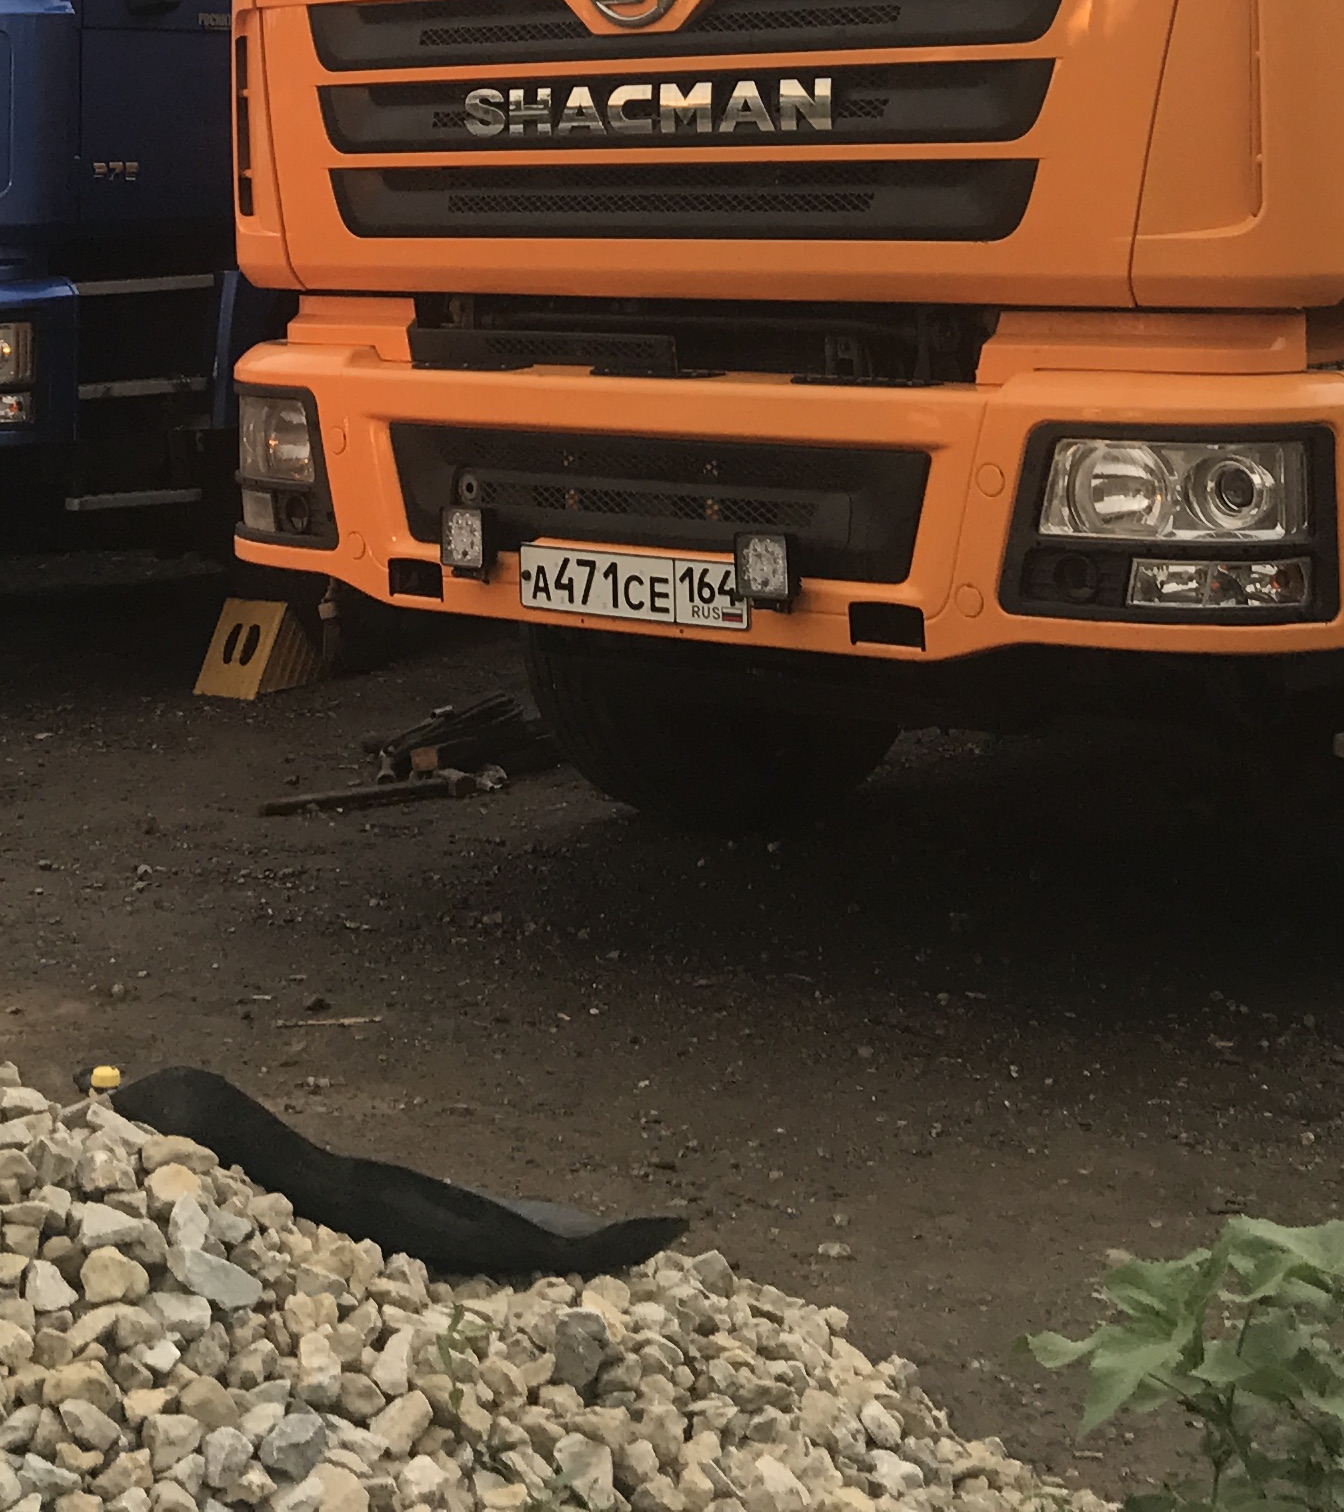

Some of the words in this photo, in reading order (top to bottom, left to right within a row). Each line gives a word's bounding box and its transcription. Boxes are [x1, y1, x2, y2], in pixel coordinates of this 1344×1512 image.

[464, 77, 833, 136] SHACMAN
[678, 566, 738, 607] 164
[691, 604, 721, 620] RUS
